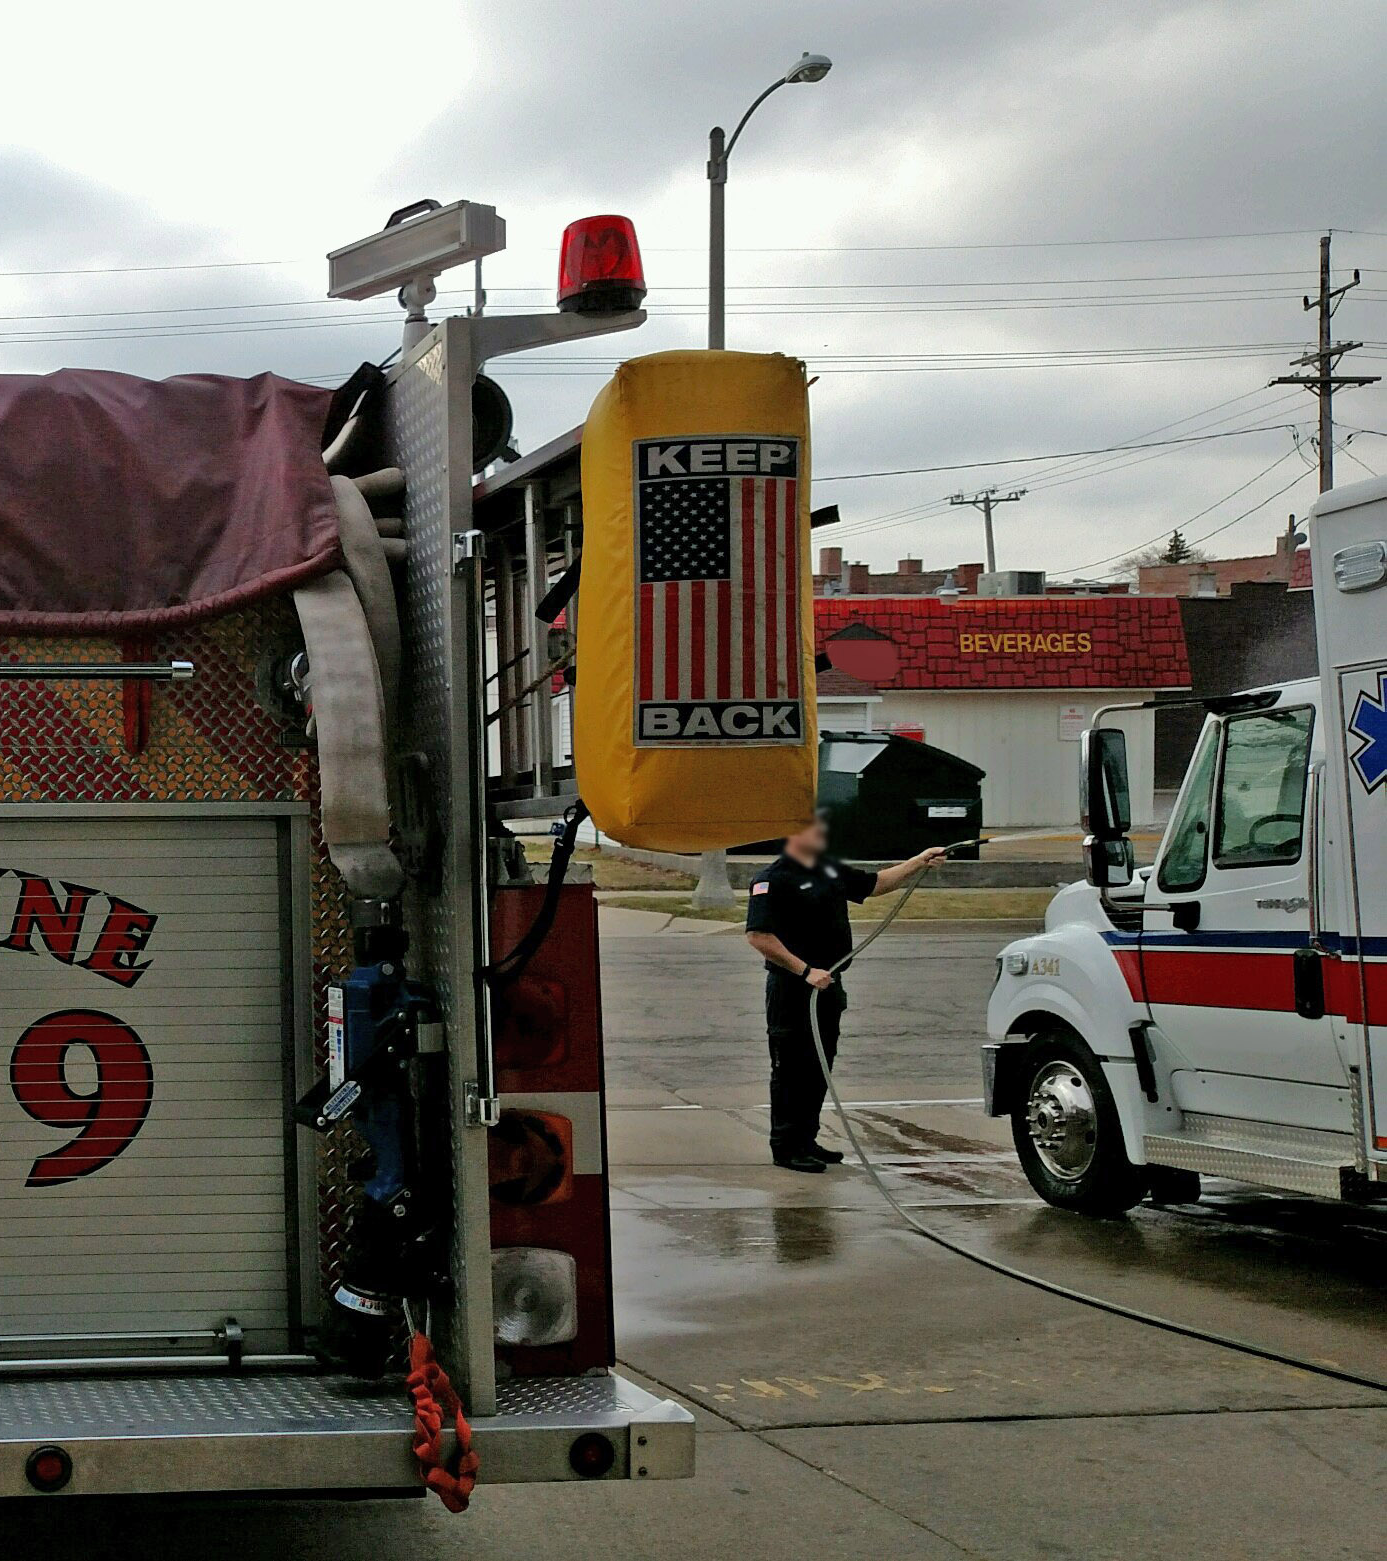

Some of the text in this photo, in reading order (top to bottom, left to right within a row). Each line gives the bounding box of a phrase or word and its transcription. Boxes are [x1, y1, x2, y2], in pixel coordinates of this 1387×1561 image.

[648, 443, 791, 475] KEEP
[959, 633, 1092, 653] BEVERAGES
[643, 705, 797, 736] BACK
